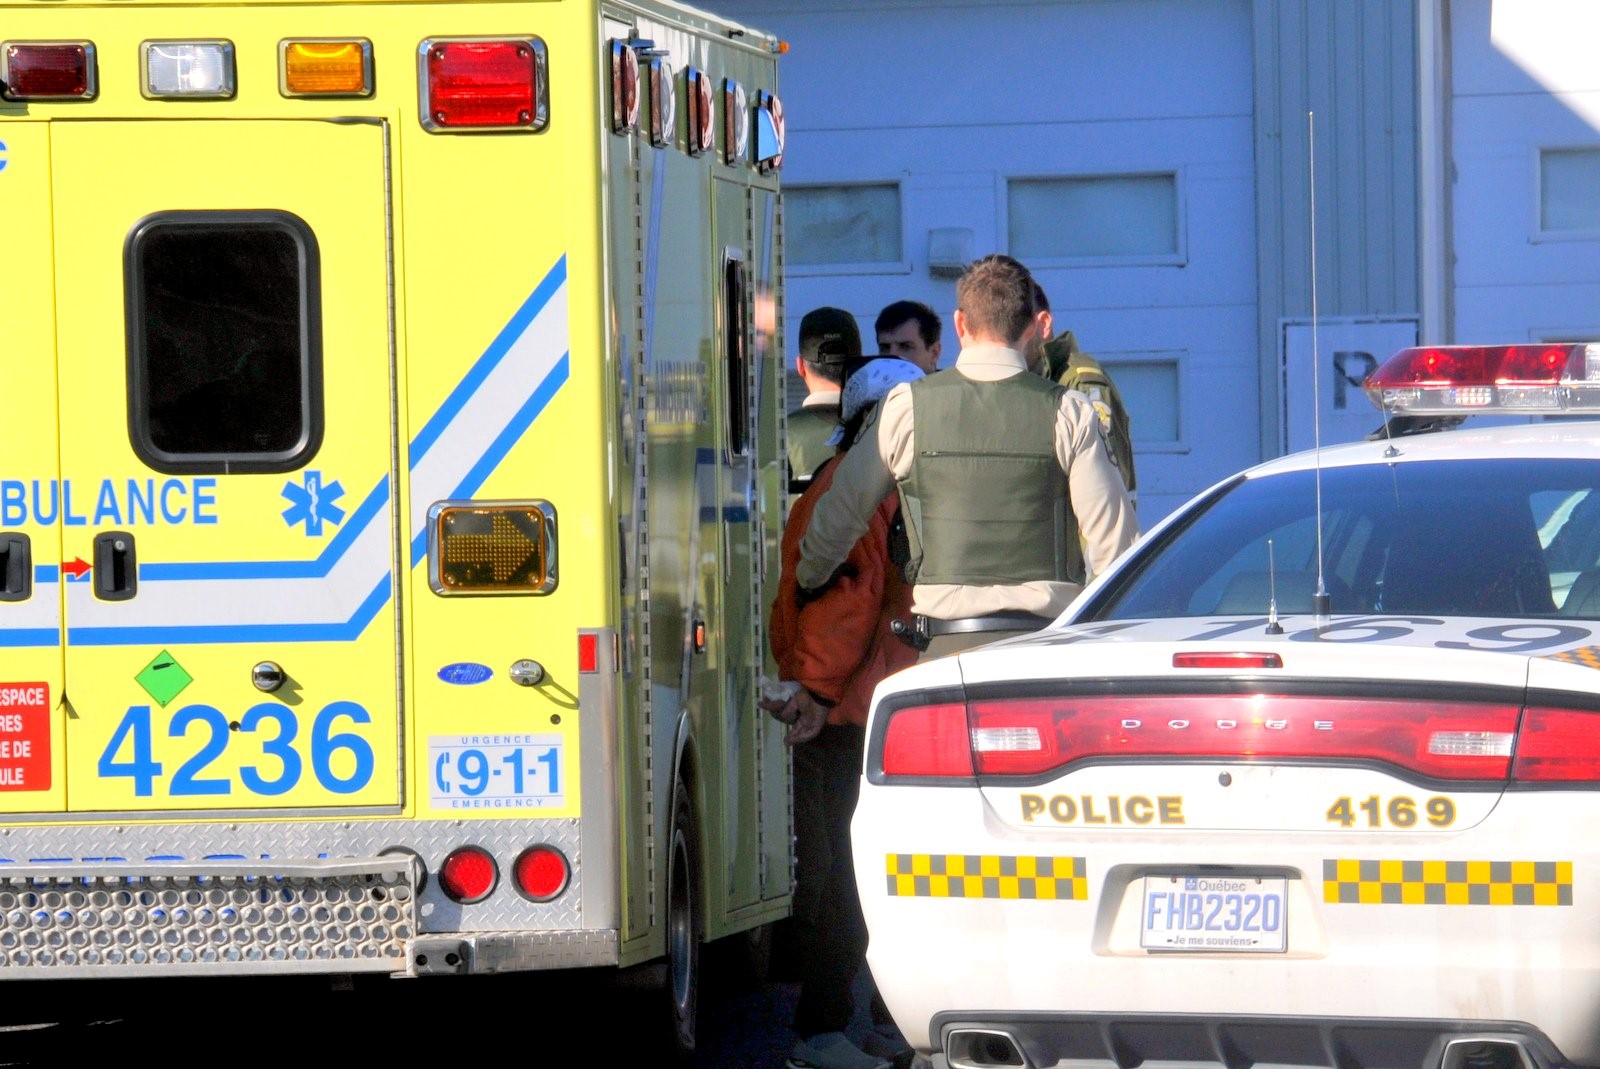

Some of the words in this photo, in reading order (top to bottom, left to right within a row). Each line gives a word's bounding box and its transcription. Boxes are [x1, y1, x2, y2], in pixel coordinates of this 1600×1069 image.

[1, 478, 218, 526] BULANCE
[0, 688, 44, 706] SPACE
[1121, 718, 1334, 731] DODGE
[13, 740, 31, 758] DE
[97, 701, 375, 797] 4236
[461, 735, 532, 745] URGENCE
[457, 747, 559, 796] 9-1-1
[452, 799, 544, 808] EMERGENCY
[1019, 793, 1186, 825] POLICE
[1325, 795, 1457, 829] 4169
[1198, 880, 1246, 892] Québec
[1147, 891, 1281, 932] FHB2320
[1173, 936, 1185, 945] Je
[1188, 937, 1204, 945] me
[1206, 936, 1252, 946] souviens
